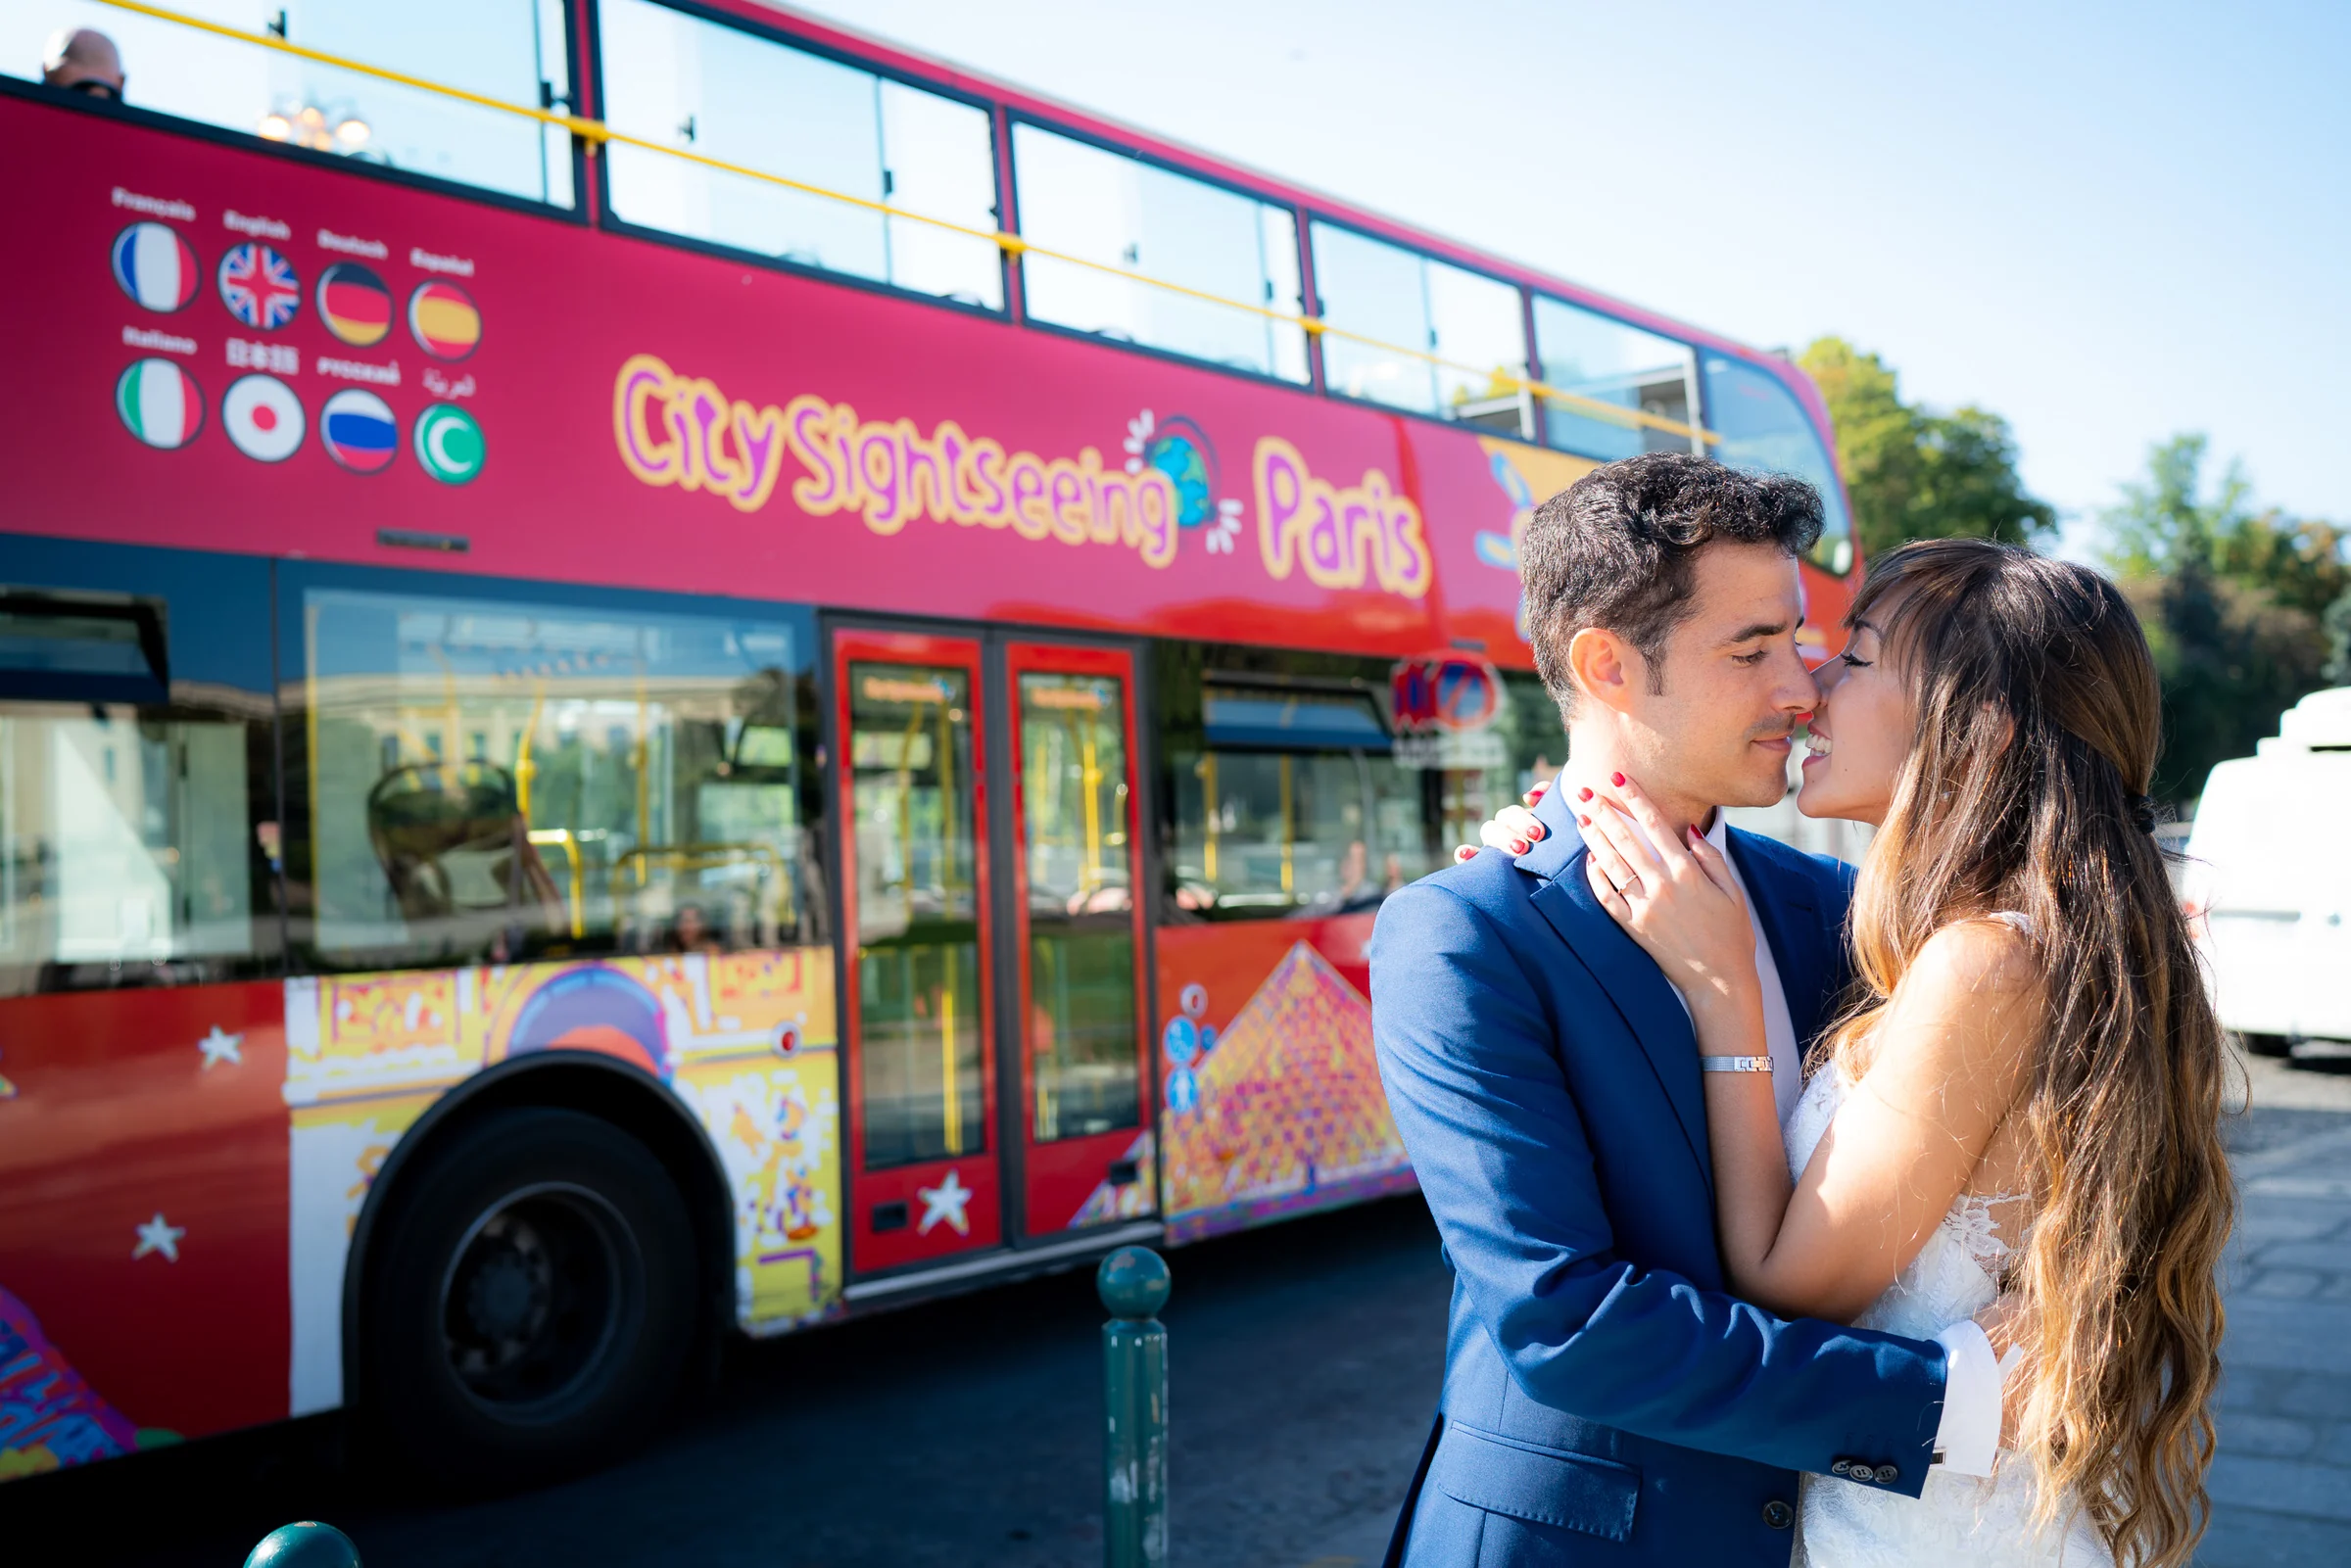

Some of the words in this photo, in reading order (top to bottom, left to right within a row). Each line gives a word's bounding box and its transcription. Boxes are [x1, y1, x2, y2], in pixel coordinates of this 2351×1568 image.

[223, 210, 291, 241] English
[121, 325, 198, 356] Italiano
[1252, 435, 1432, 599] Paris
